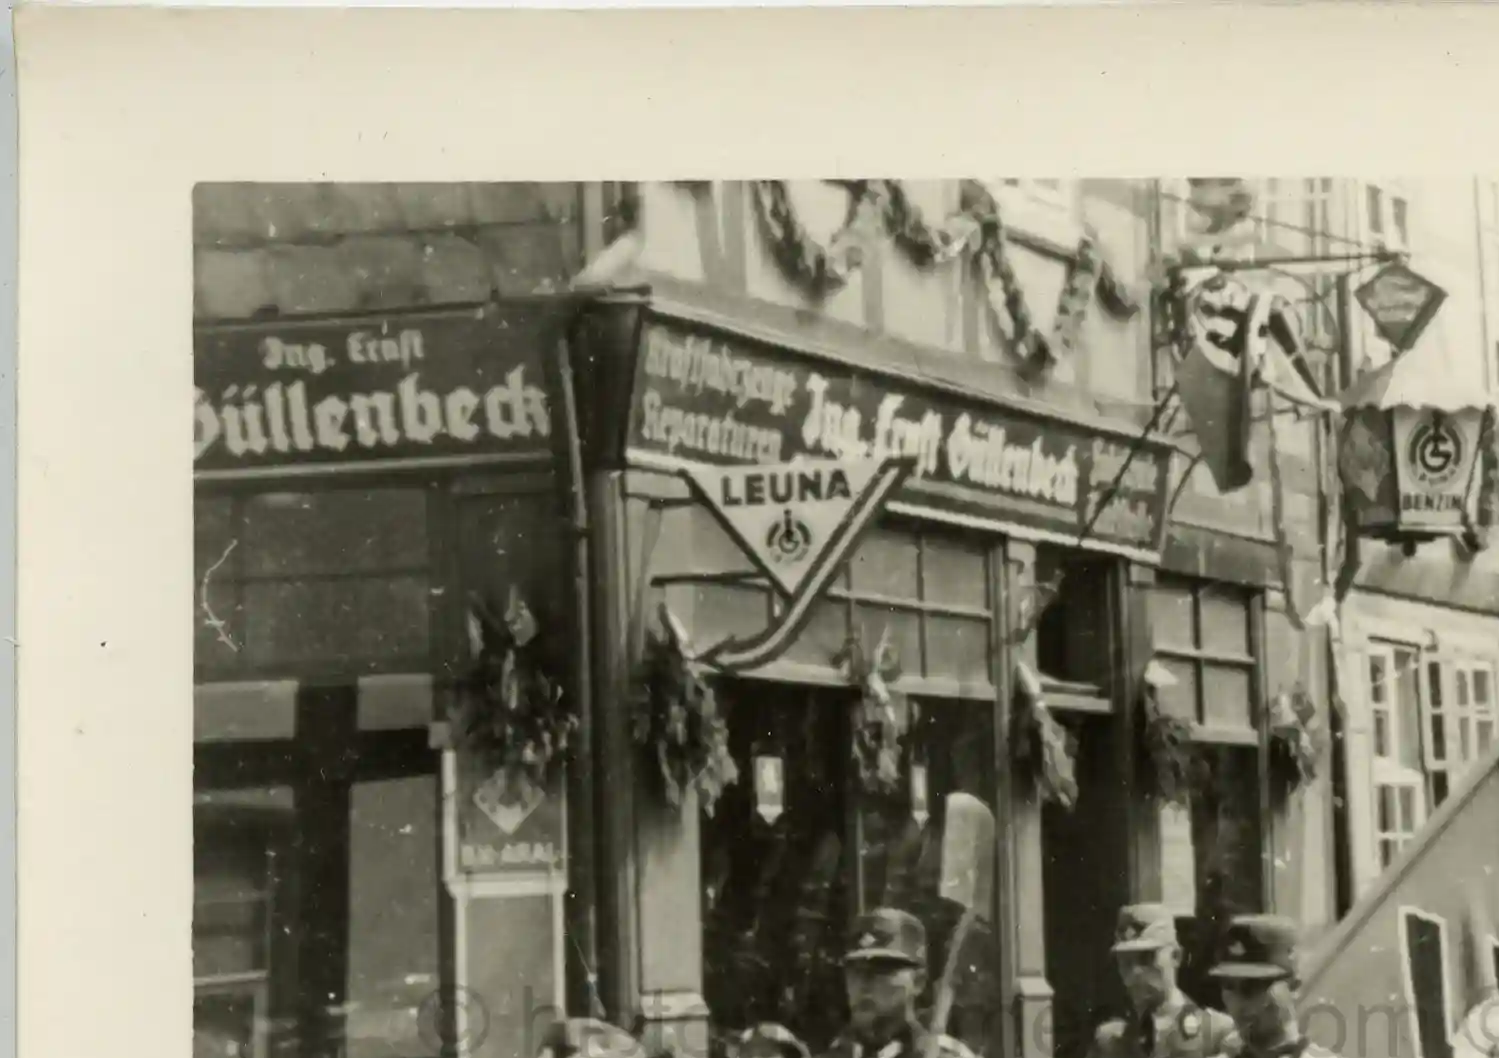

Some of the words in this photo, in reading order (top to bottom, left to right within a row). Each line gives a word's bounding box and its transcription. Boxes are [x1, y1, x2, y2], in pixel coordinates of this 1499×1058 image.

[260, 335, 336, 375] Ing.
[721, 468, 852, 506] LEUNA
[1401, 494, 1463, 512] BENZIN
